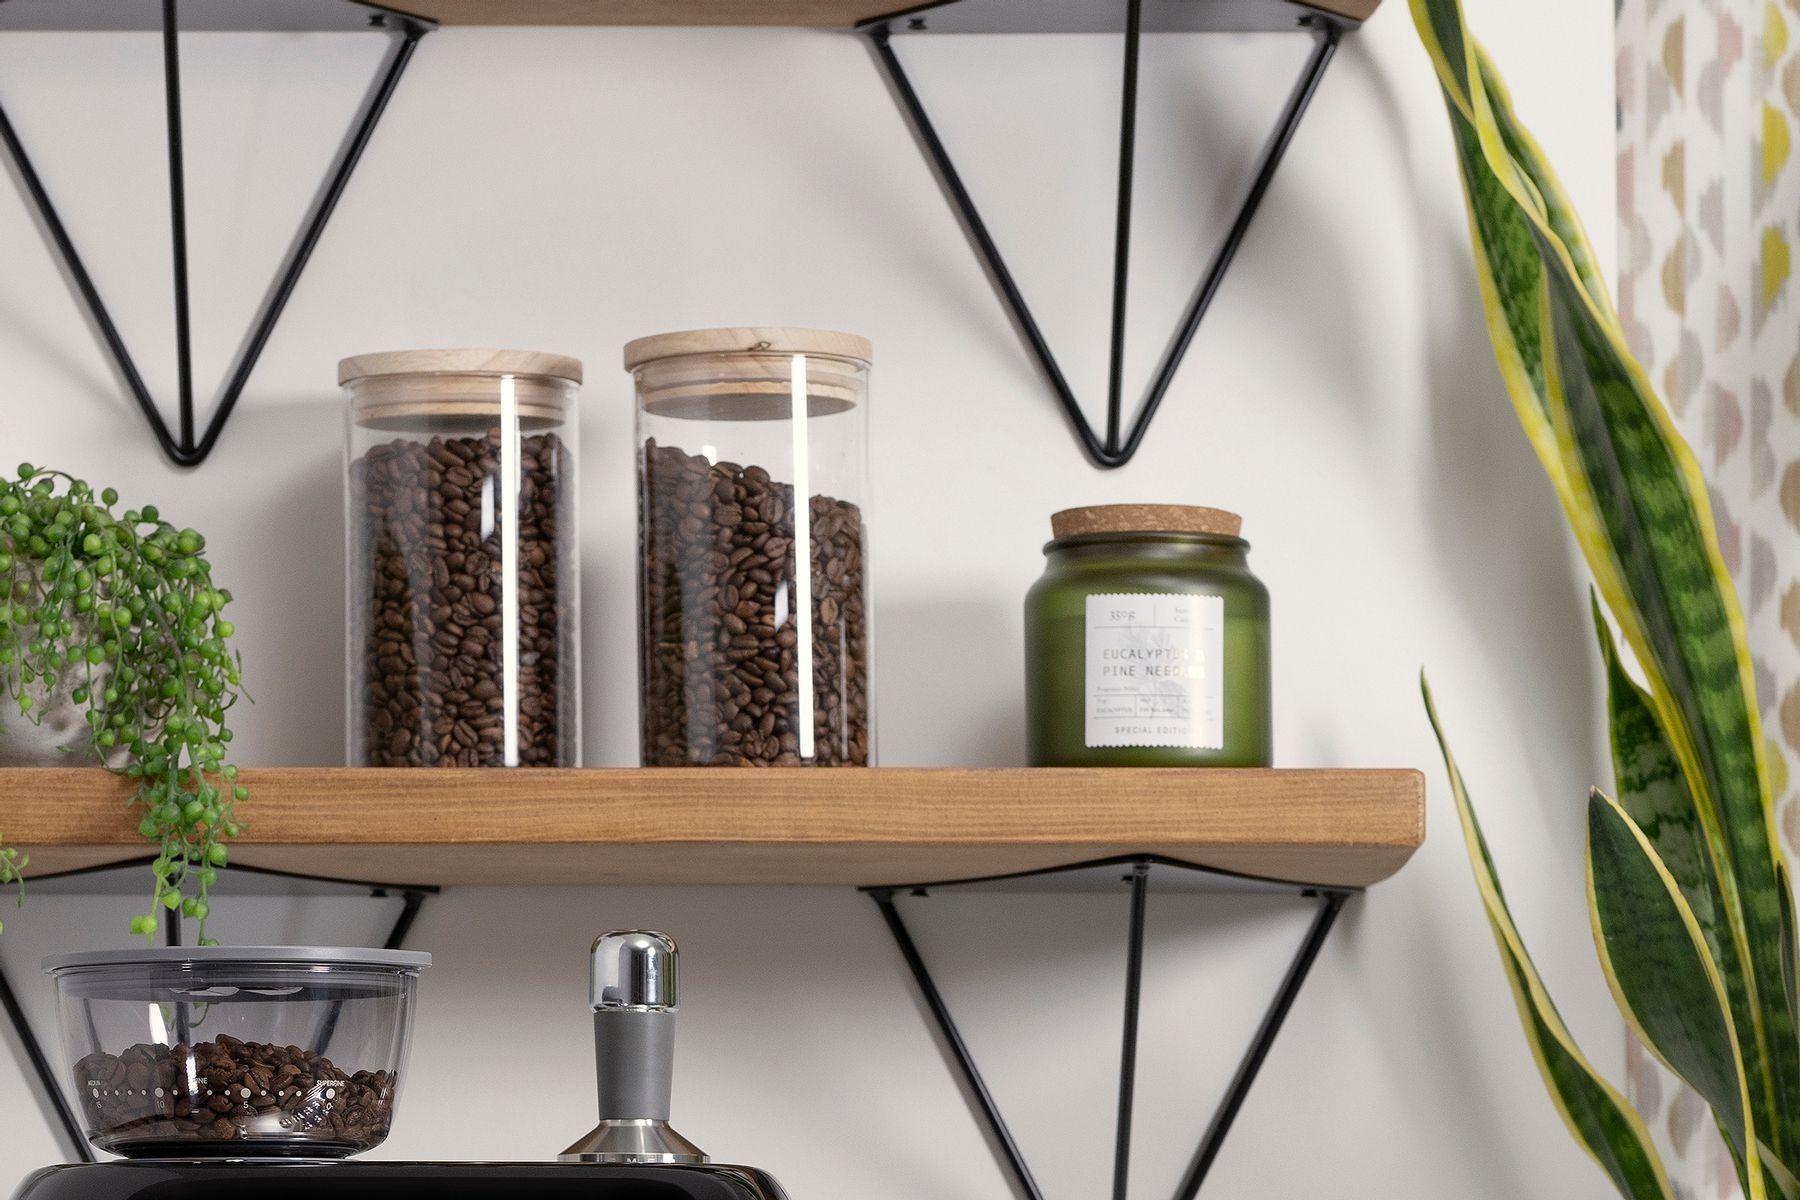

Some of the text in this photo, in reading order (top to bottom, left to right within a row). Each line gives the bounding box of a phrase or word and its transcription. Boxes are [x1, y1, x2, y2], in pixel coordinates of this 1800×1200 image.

[1103, 665, 1136, 677] PINE
[1115, 726, 1194, 735] SPECIAL EDITIO
[243, 1101, 249, 1109] 5
